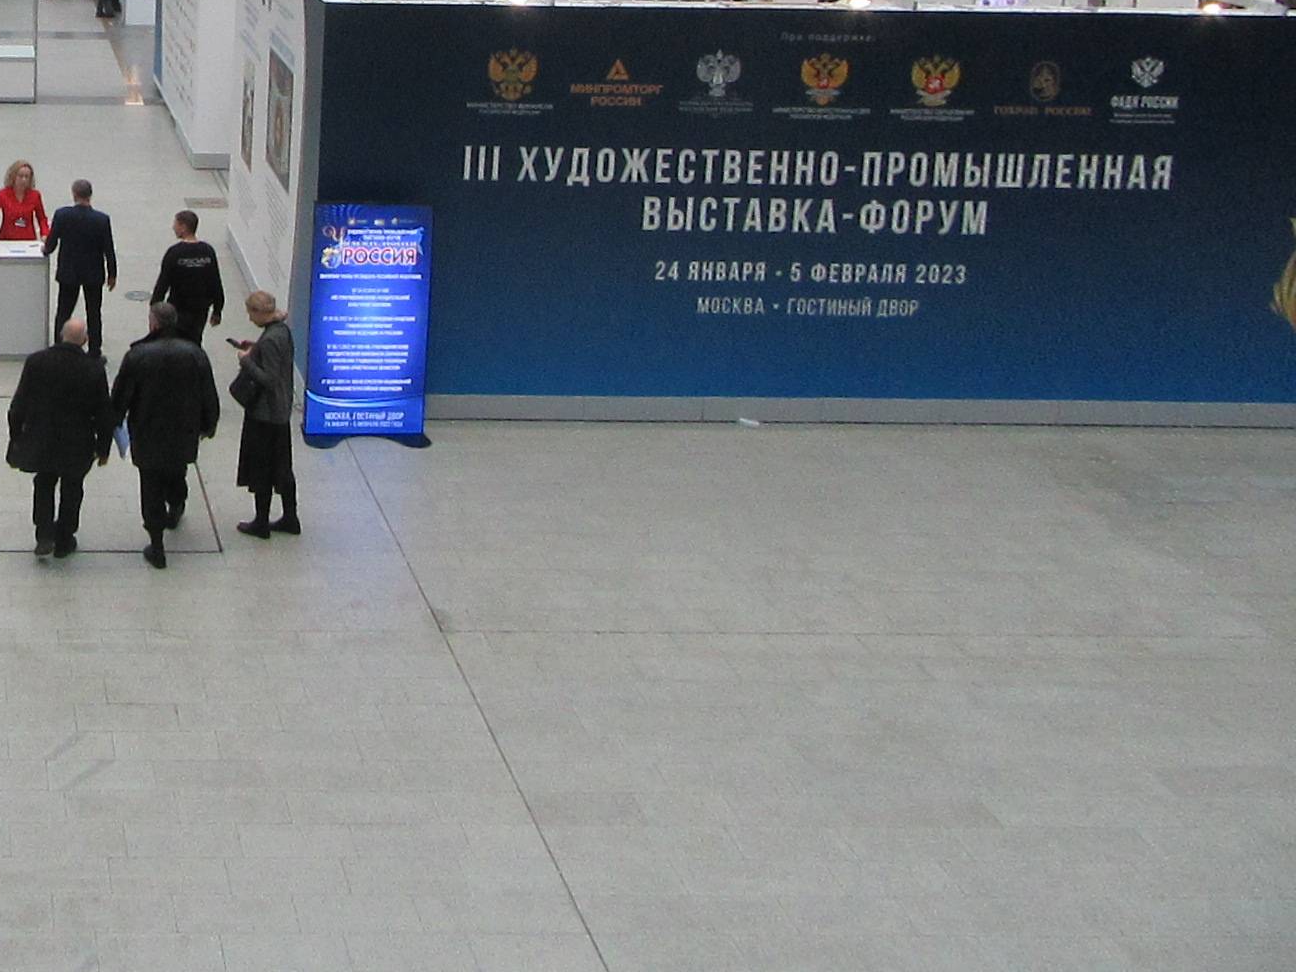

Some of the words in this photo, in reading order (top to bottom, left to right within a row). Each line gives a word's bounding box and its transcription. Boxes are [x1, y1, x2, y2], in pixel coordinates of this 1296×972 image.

[570, 83, 664, 95] МИНПРОМТОРГ
[591, 96, 642, 106] РОССИИ
[1140, 95, 1180, 109] РОССИИ
[463, 145, 501, 181] III
[517, 147, 1174, 191] ХУДОЖЕСТВЕННО-ПРОМЫШЛЕННАЯ
[642, 196, 989, 235] ВЫСТАВКА-ФОРУМ
[343, 247, 417, 265] РОССИЯ
[655, 261, 679, 281] 24
[687, 261, 766, 281] ЯНВАРЯ
[790, 262, 801, 282] 5
[810, 263, 907, 284] ФЕВРАЛЯ
[915, 264, 967, 284] 2023
[696, 296, 766, 315] МОСКВА
[786, 296, 871, 316] ГОСТИНЫЙ
[876, 297, 921, 318] ДВОР
